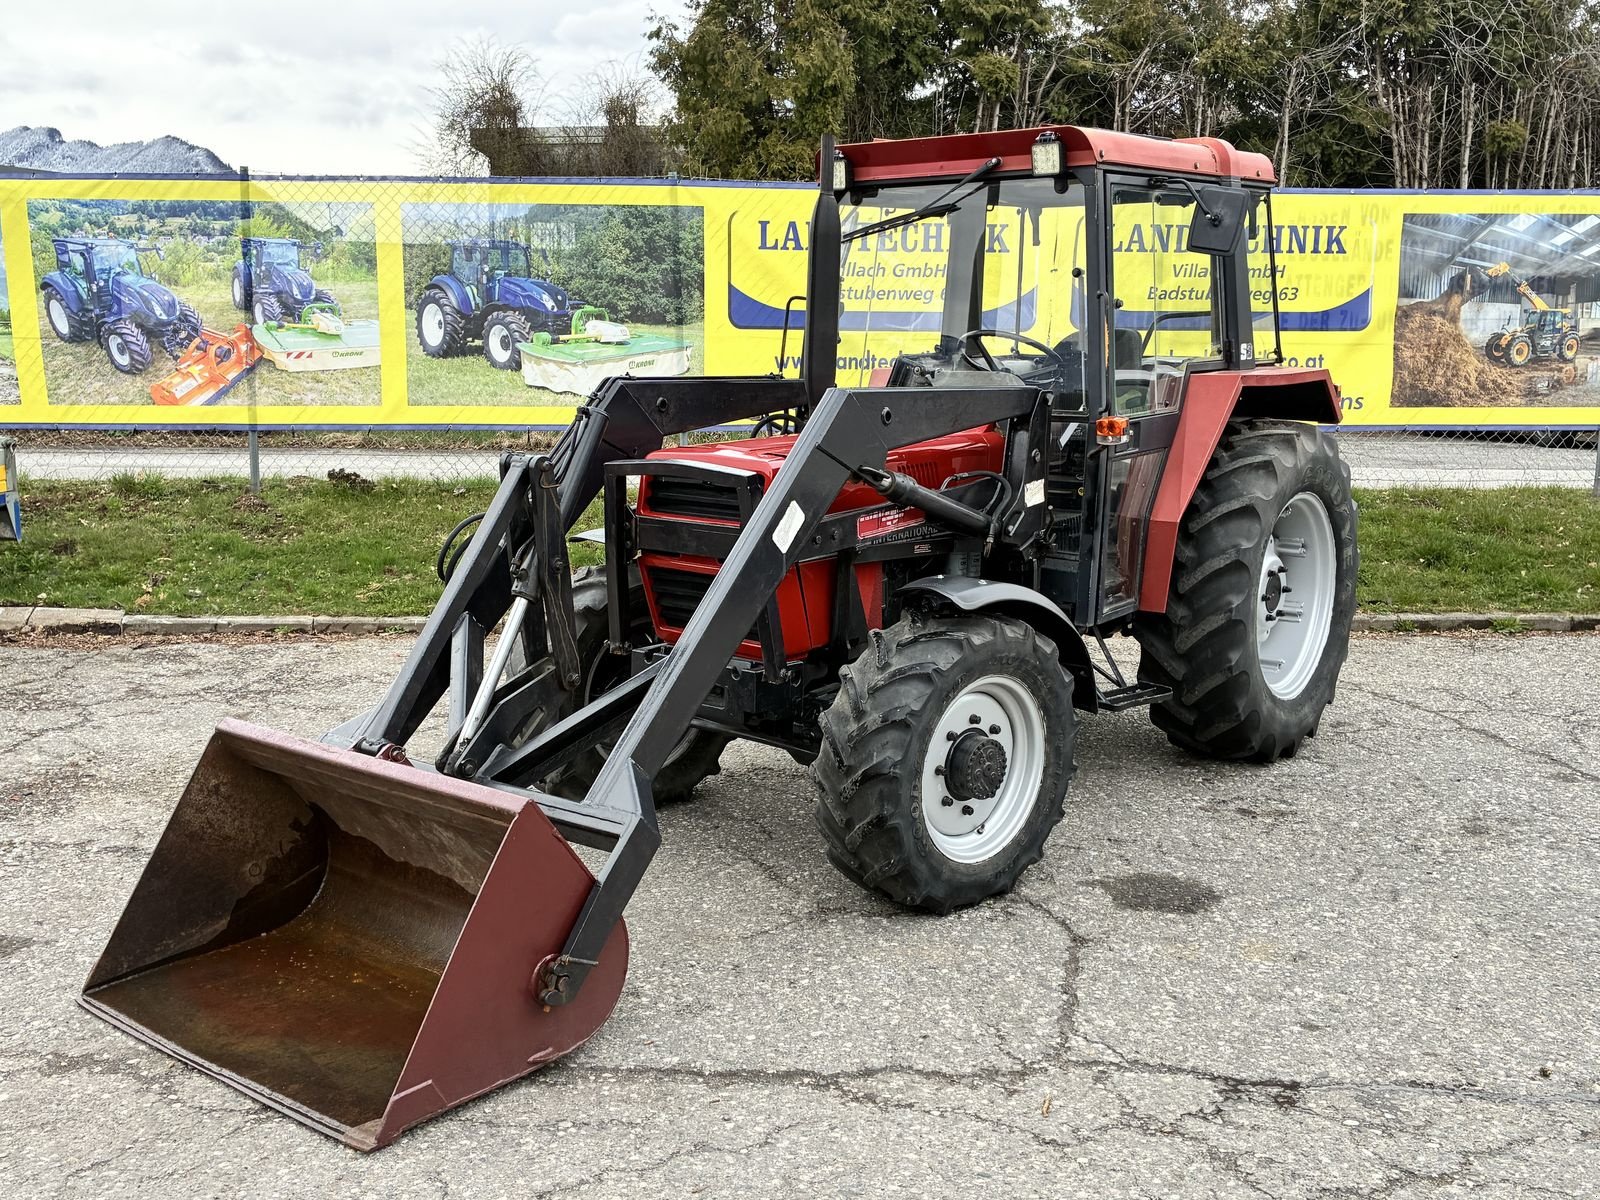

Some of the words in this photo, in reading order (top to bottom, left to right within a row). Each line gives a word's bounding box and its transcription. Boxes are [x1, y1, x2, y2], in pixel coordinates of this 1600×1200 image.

[892, 262, 947, 278] GmbH
[1172, 263, 1210, 278] Villa
[1248, 263, 1286, 278] mbH
[840, 285, 934, 305] stubenweg
[1278, 287, 1299, 301] 63
[635, 359, 656, 369] KRONE
